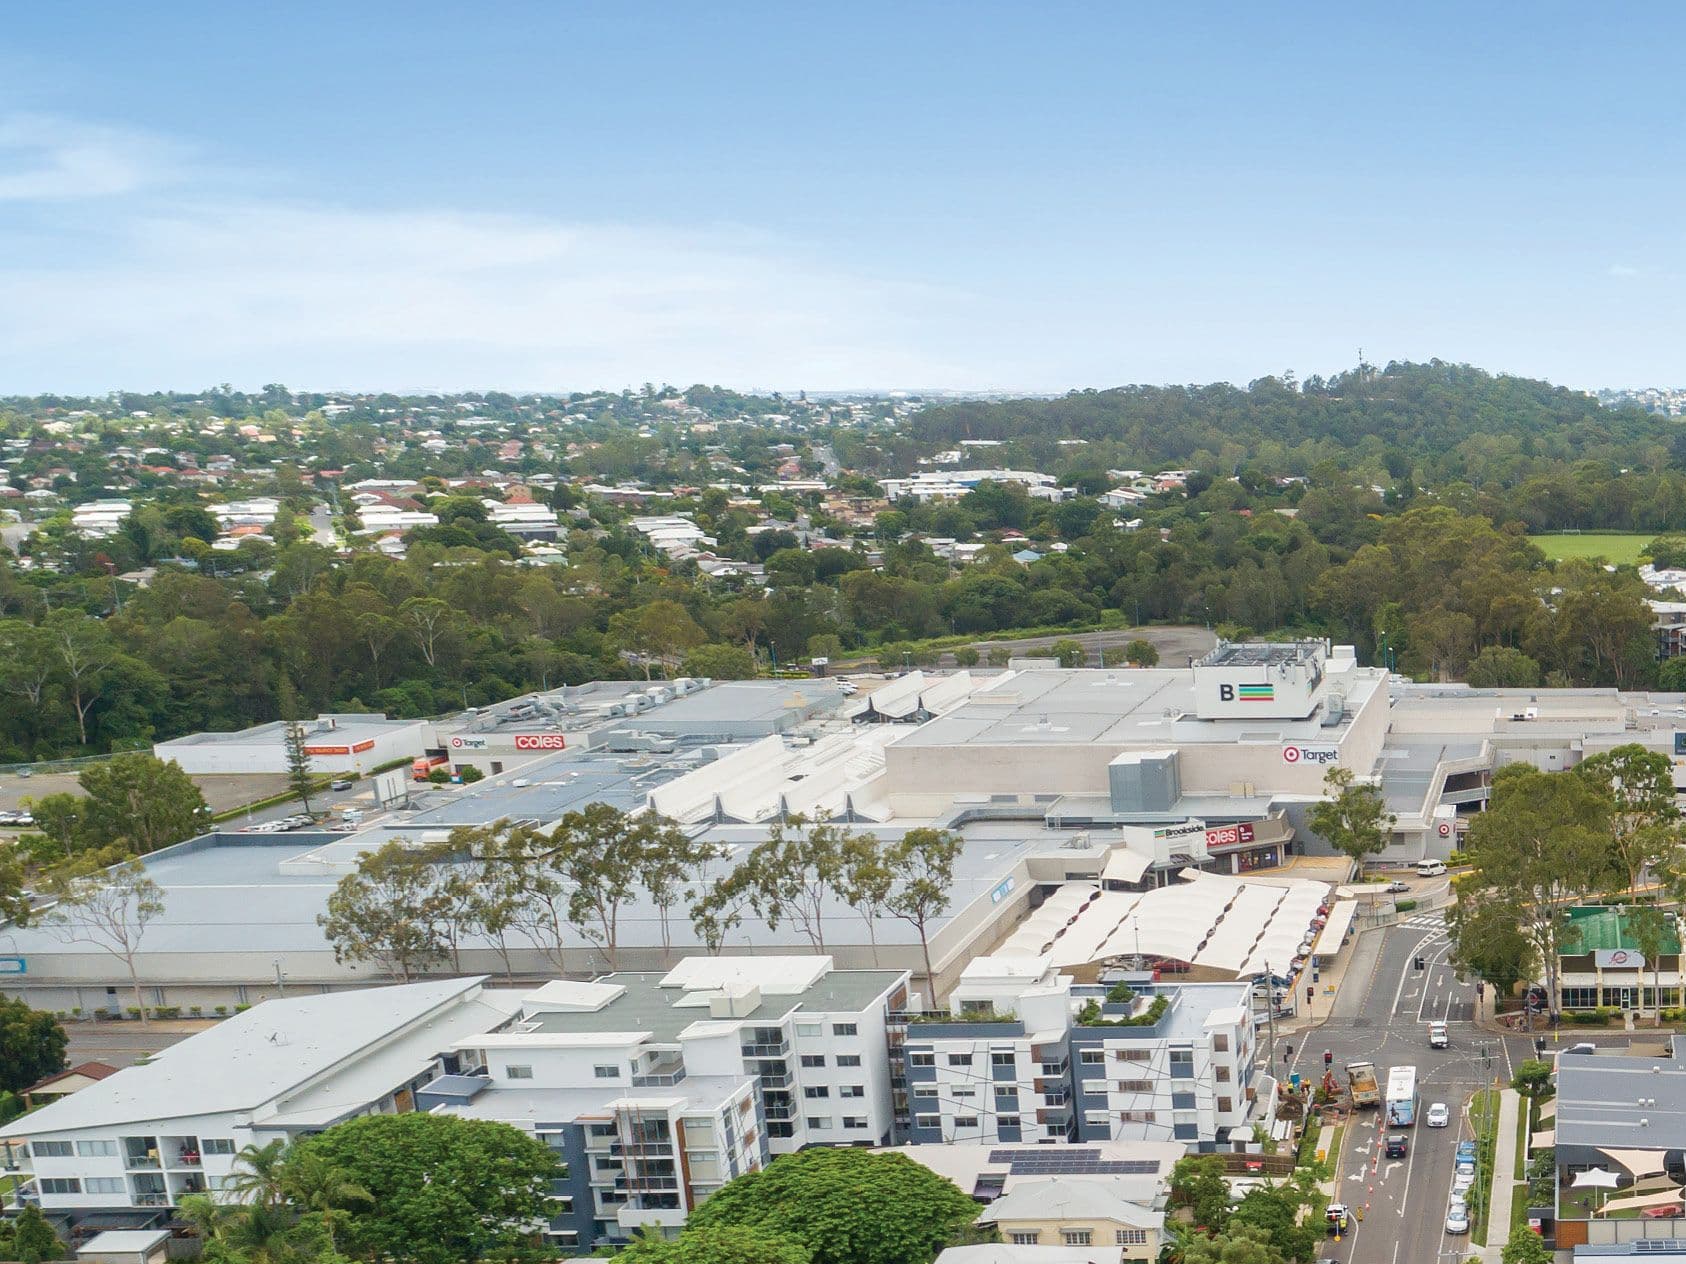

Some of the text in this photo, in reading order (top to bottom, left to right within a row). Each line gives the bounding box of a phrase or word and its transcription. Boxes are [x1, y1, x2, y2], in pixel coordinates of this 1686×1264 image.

[463, 738, 486, 749] Target
[517, 735, 563, 749] coles
[1300, 749, 1338, 764] Target
[1165, 825, 1204, 837] Brookside
